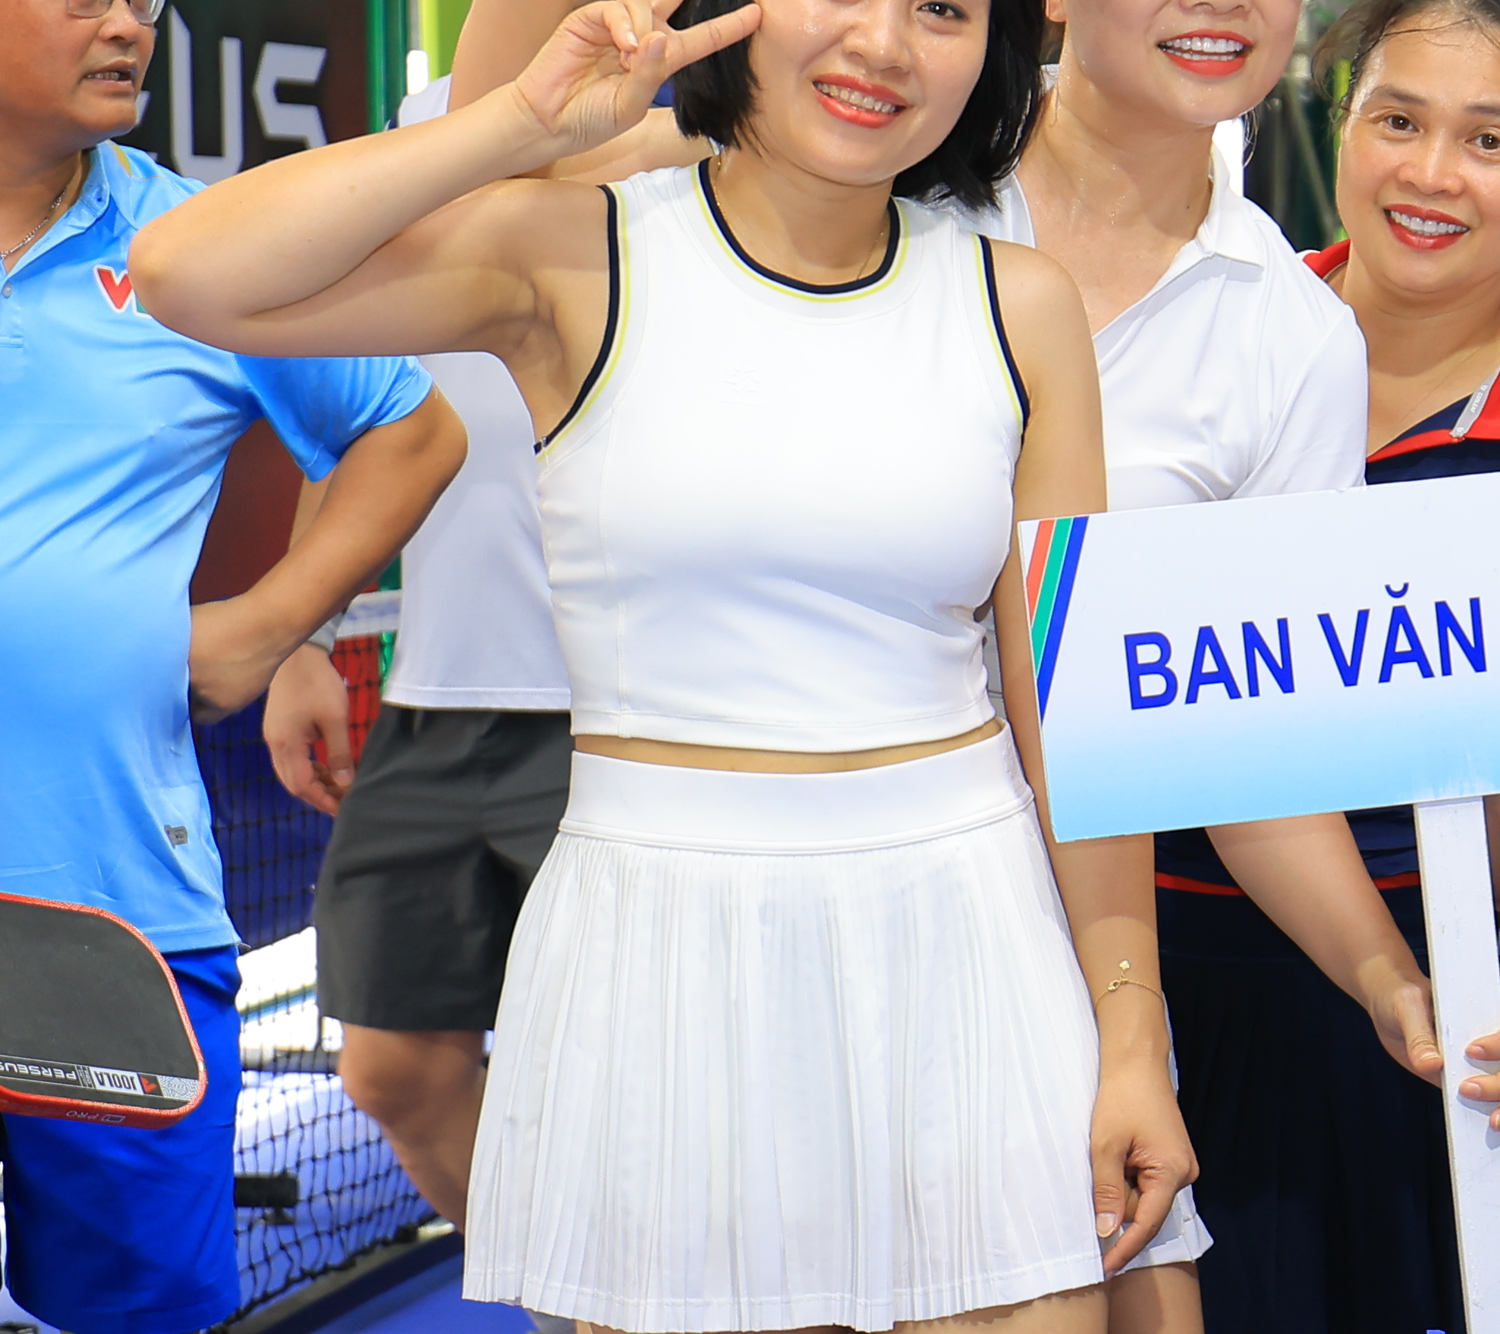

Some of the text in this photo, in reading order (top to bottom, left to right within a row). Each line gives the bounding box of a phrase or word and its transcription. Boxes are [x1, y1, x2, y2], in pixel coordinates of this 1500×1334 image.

[1124, 618, 1296, 710] BAN
[1318, 582, 1487, 688] VĂN
[94, 1069, 138, 1091] JOOLA
